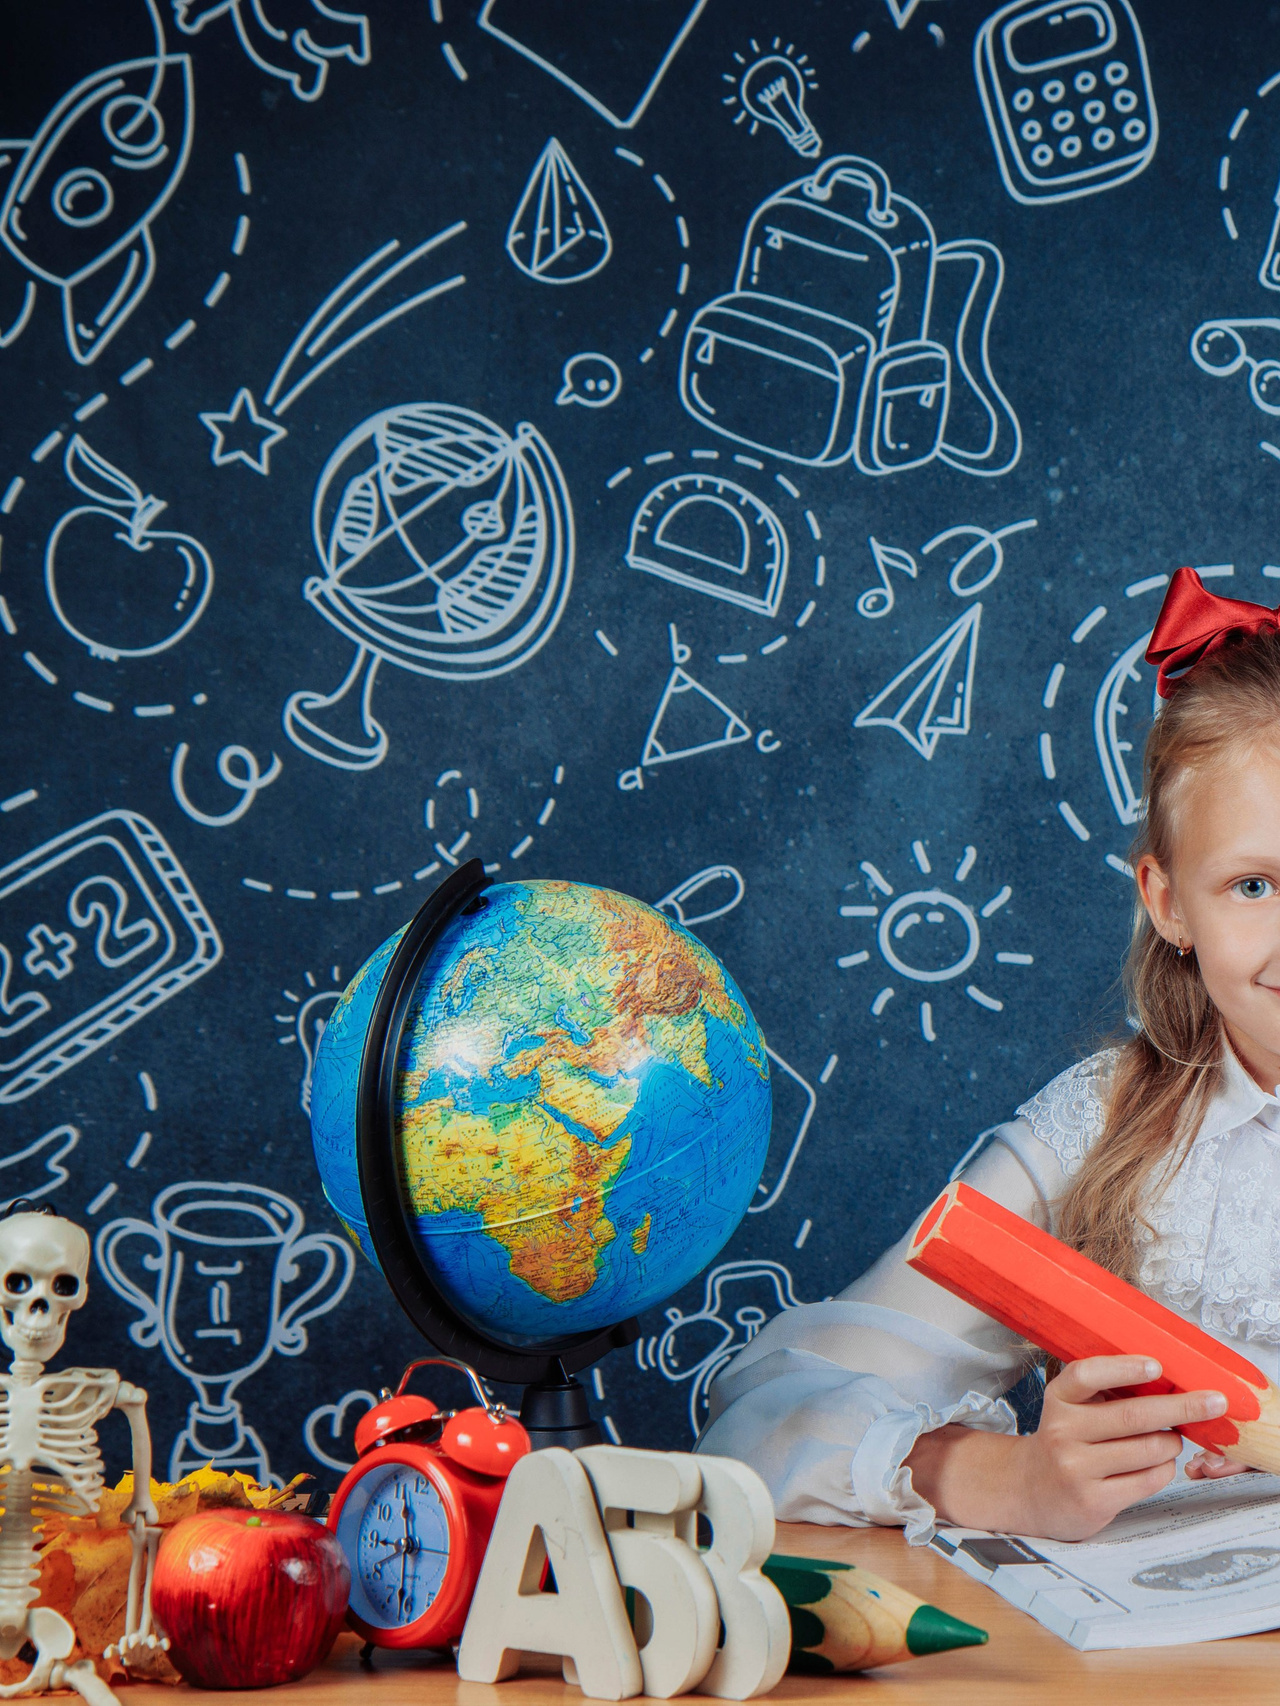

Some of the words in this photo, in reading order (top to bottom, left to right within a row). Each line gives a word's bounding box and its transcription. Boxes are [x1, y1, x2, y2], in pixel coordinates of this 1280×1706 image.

[669, 623, 692, 664] b
[756, 729, 782, 753] c
[618, 766, 644, 790] a
[394, 1482, 407, 1500] 11
[414, 1476, 430, 1495] 12
[376, 1502, 392, 1522] 10
[368, 1529, 379, 1549] 9
[371, 1561, 382, 1581] 8
[385, 1584, 396, 1604] 7
